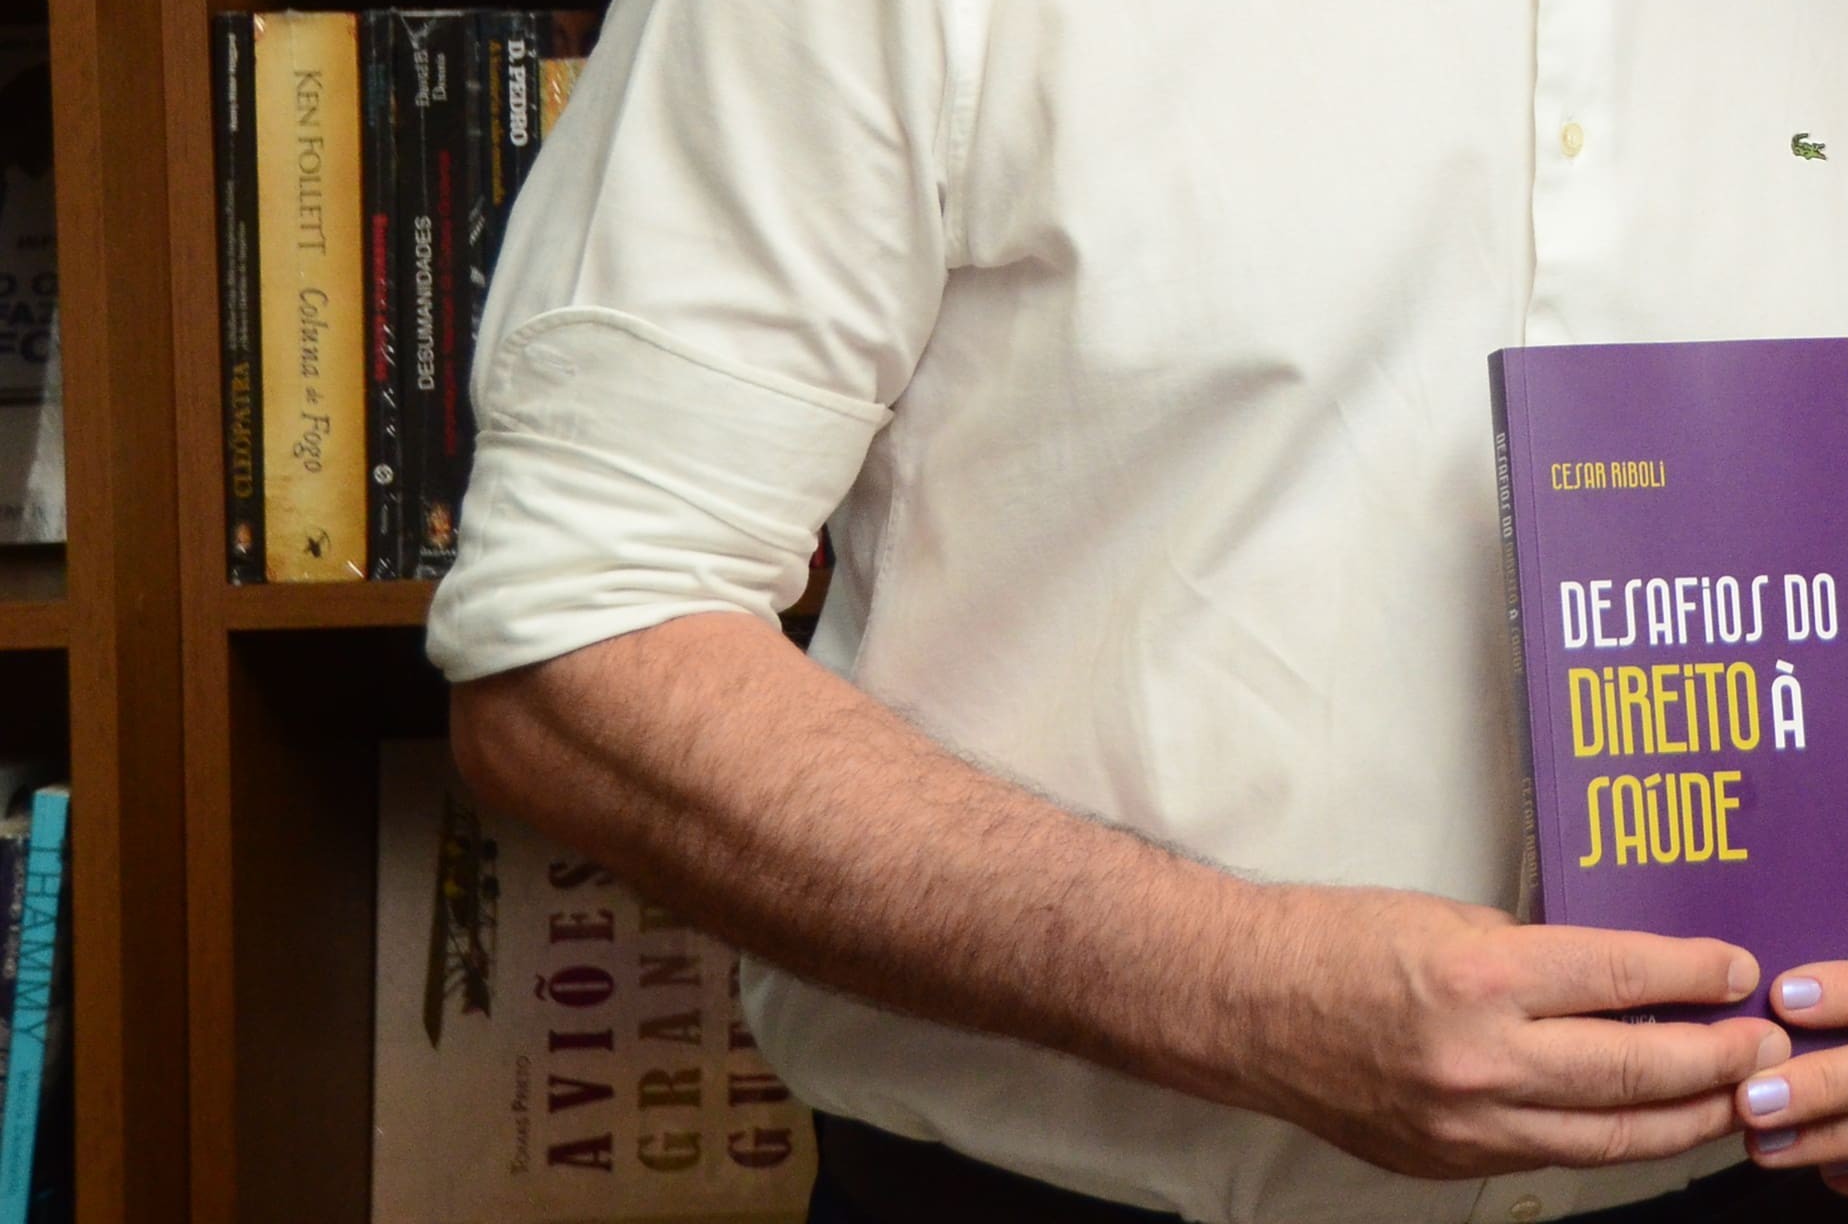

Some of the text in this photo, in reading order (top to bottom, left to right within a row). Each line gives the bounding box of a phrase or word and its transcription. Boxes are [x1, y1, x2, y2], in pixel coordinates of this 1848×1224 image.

[506, 39, 529, 147] D. PEDRO
[293, 68, 328, 258] KEN FOLLETT
[411, 213, 437, 390] DESUMANIDADES
[291, 287, 331, 475] Coluna de Fogo
[1491, 431, 1513, 513] DESAFIOS
[1551, 459, 1666, 490] CESAR RIBOLI
[1499, 514, 1515, 540] DO
[1560, 572, 1838, 650] DESAFIOS DO
[1568, 658, 1806, 758] DIREITO À
[1579, 769, 1748, 868] SAÚDE
[533, 860, 614, 1173] AVIÕES
